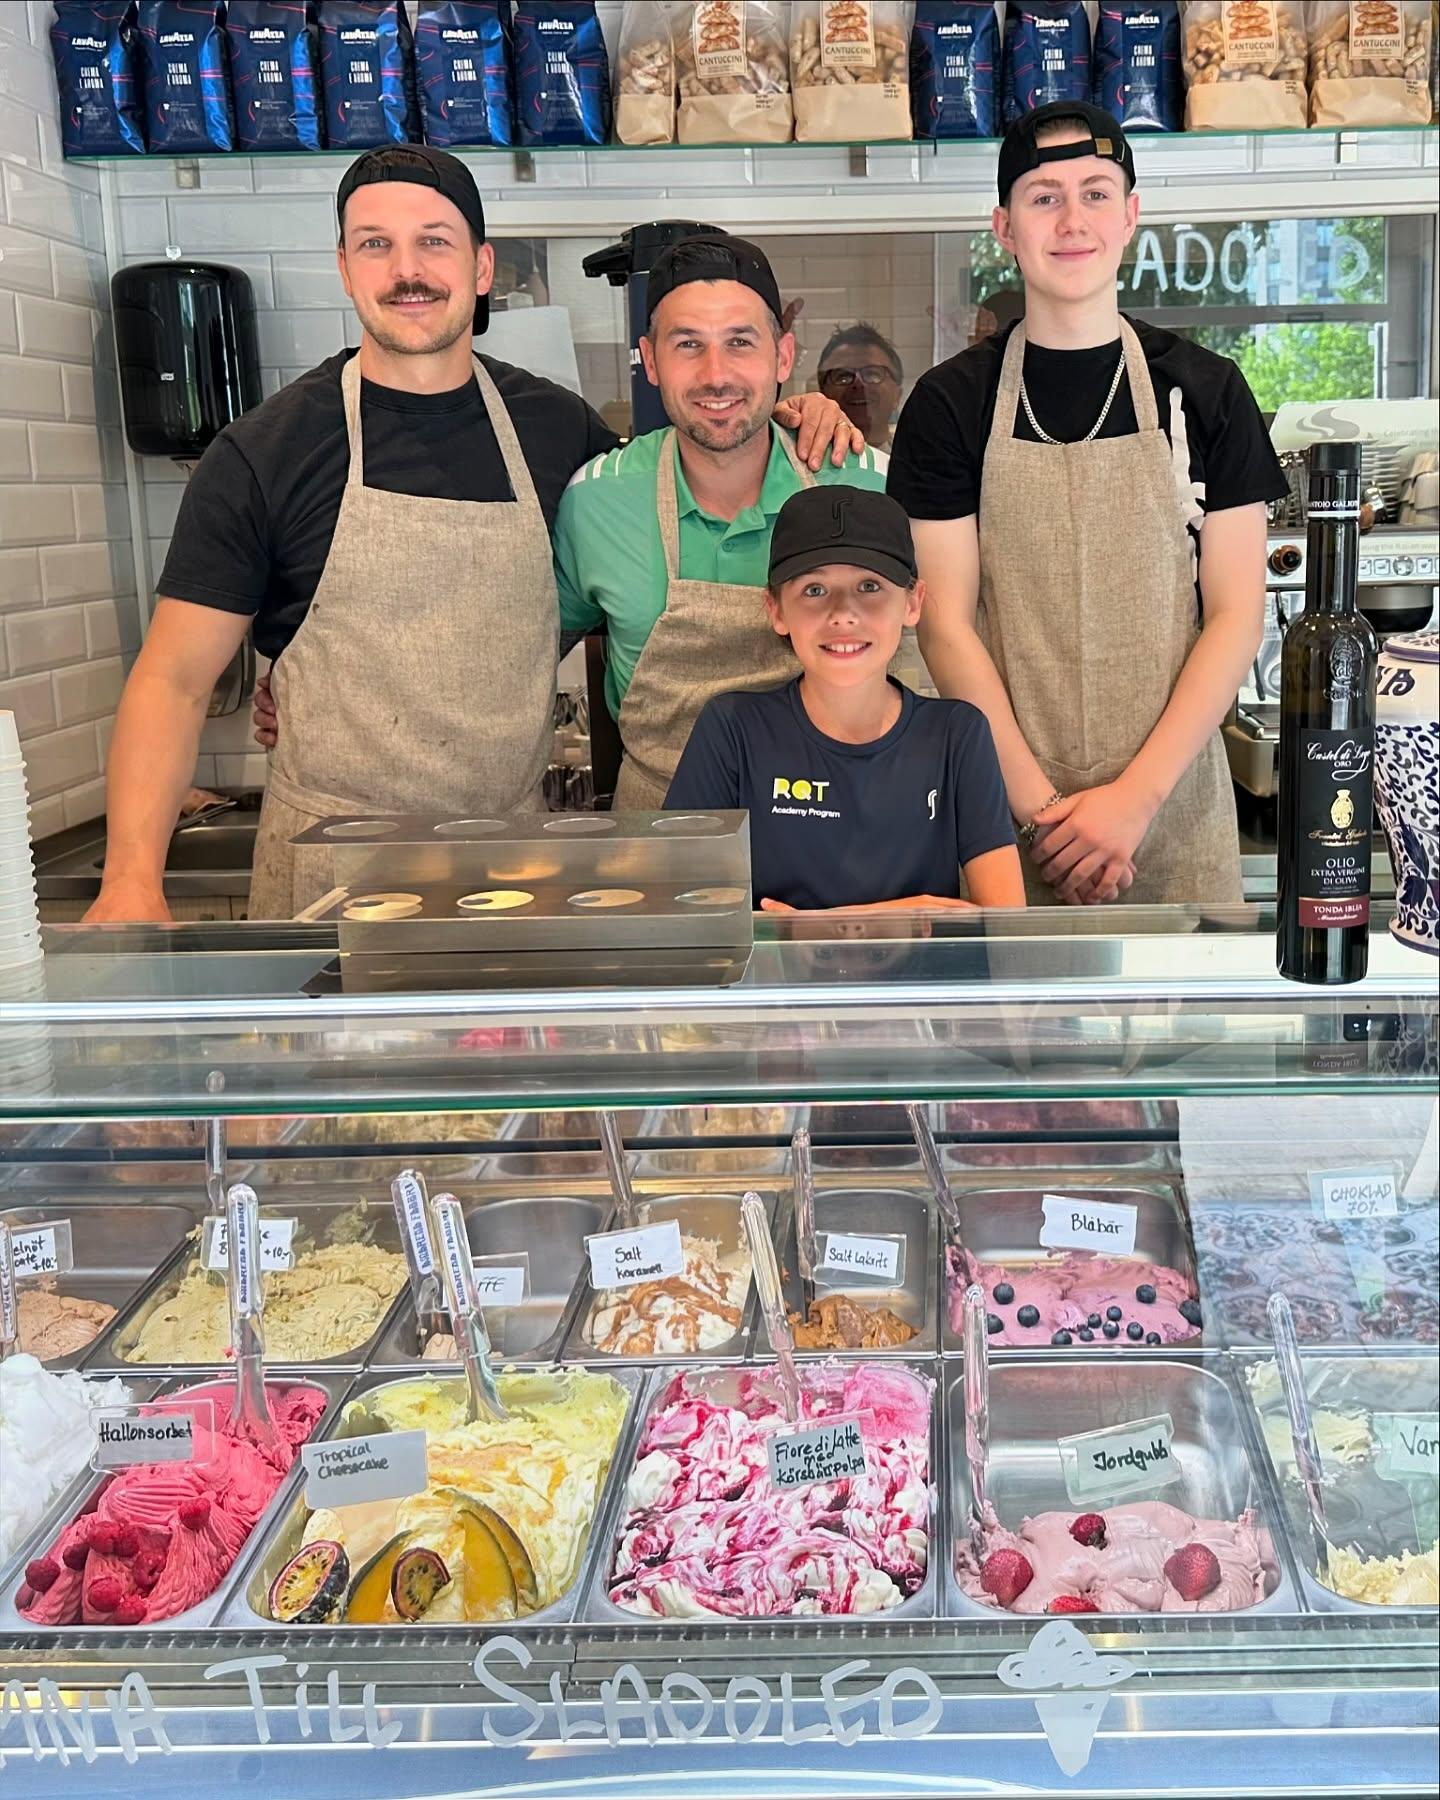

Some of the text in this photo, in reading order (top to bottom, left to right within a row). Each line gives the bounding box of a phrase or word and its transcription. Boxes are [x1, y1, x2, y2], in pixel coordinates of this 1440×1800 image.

[538, 19, 574, 30] LAVAZZA
[1035, 18, 1070, 28] LAVAZZA
[1125, 14, 1160, 25] LAVAZZA
[250, 28, 285, 39] LAVAZZA
[341, 28, 376, 40] LAVAZZA
[443, 29, 478, 40] LAVAZZA
[937, 23, 972, 35] LAVAZZA
[72, 37, 106, 48] LAVAZZA
[160, 32, 194, 43] LAVAZZA
[825, 45, 871, 55] CANTUCCINI
[1229, 42, 1275, 51] CANTUCCINI
[1354, 40, 1400, 48] CANTUCCINI
[699, 55, 743, 66] CANTUCCINI
[773, 778, 830, 801] RQT
[771, 805, 840, 818] Academy Program
[1326, 856, 1355, 869] OLIO
[1311, 866, 1365, 877] EXTRA VERGINE
[1323, 876, 1357, 885] DI OLIVA
[1313, 905, 1343, 914] TONDA
[1331, 1183, 1391, 1203] CHOKLAD
[1071, 1213, 1124, 1234] Blåbär
[14, 1235, 46, 1256] elnöt
[615, 1246, 642, 1263] Salt
[99, 1420, 192, 1443] Hallonsorbet
[313, 1442, 372, 1463] Tropical
[775, 1441, 813, 1463] Fiore
[814, 1435, 829, 1453] di
[1093, 1438, 1168, 1471] Jordgubb
[804, 1450, 834, 1466] med
[317, 1458, 389, 1479] Cheesecake
